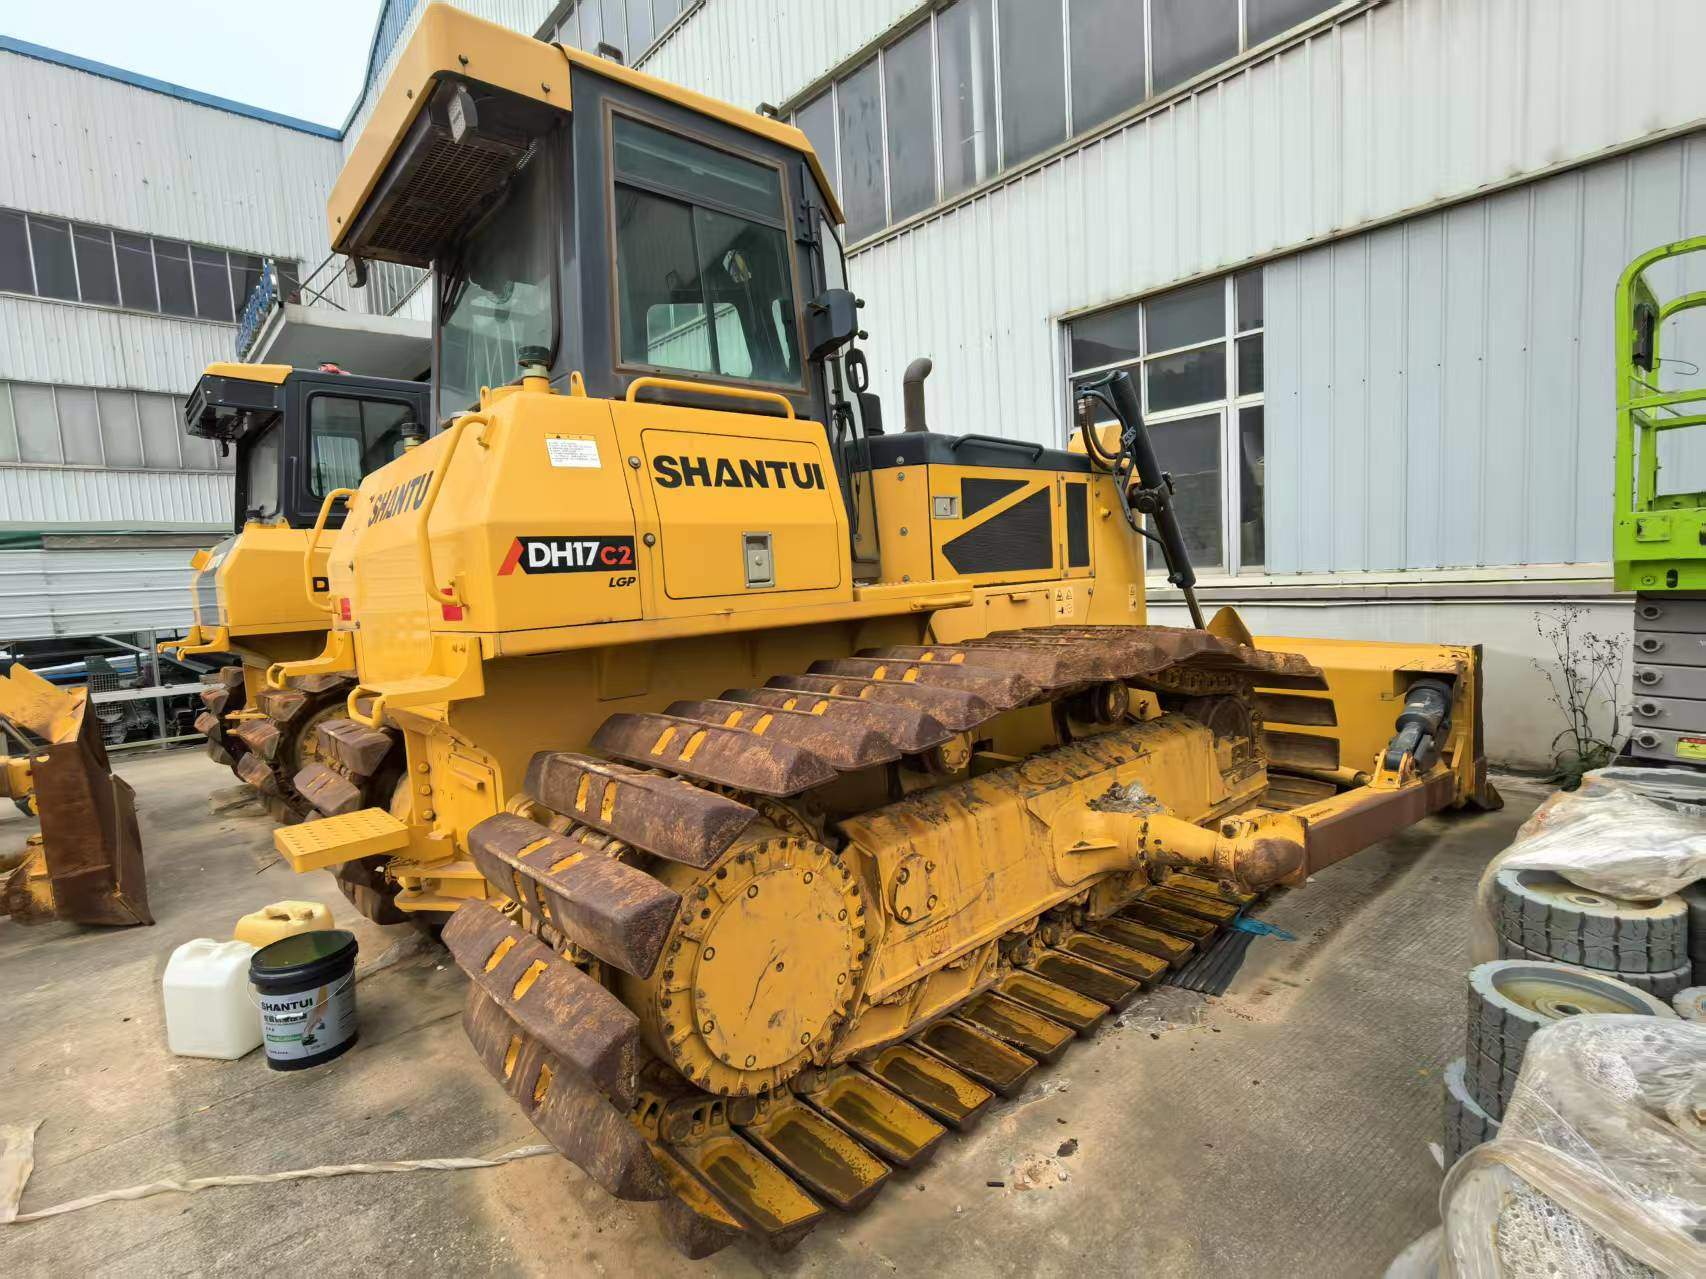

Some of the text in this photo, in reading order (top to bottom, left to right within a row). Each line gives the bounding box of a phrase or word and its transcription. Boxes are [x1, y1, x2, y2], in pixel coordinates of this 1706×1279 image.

[652, 455, 825, 490] SHANTUI
[608, 577, 637, 588] LGP
[261, 997, 313, 1011] SHANTUI
